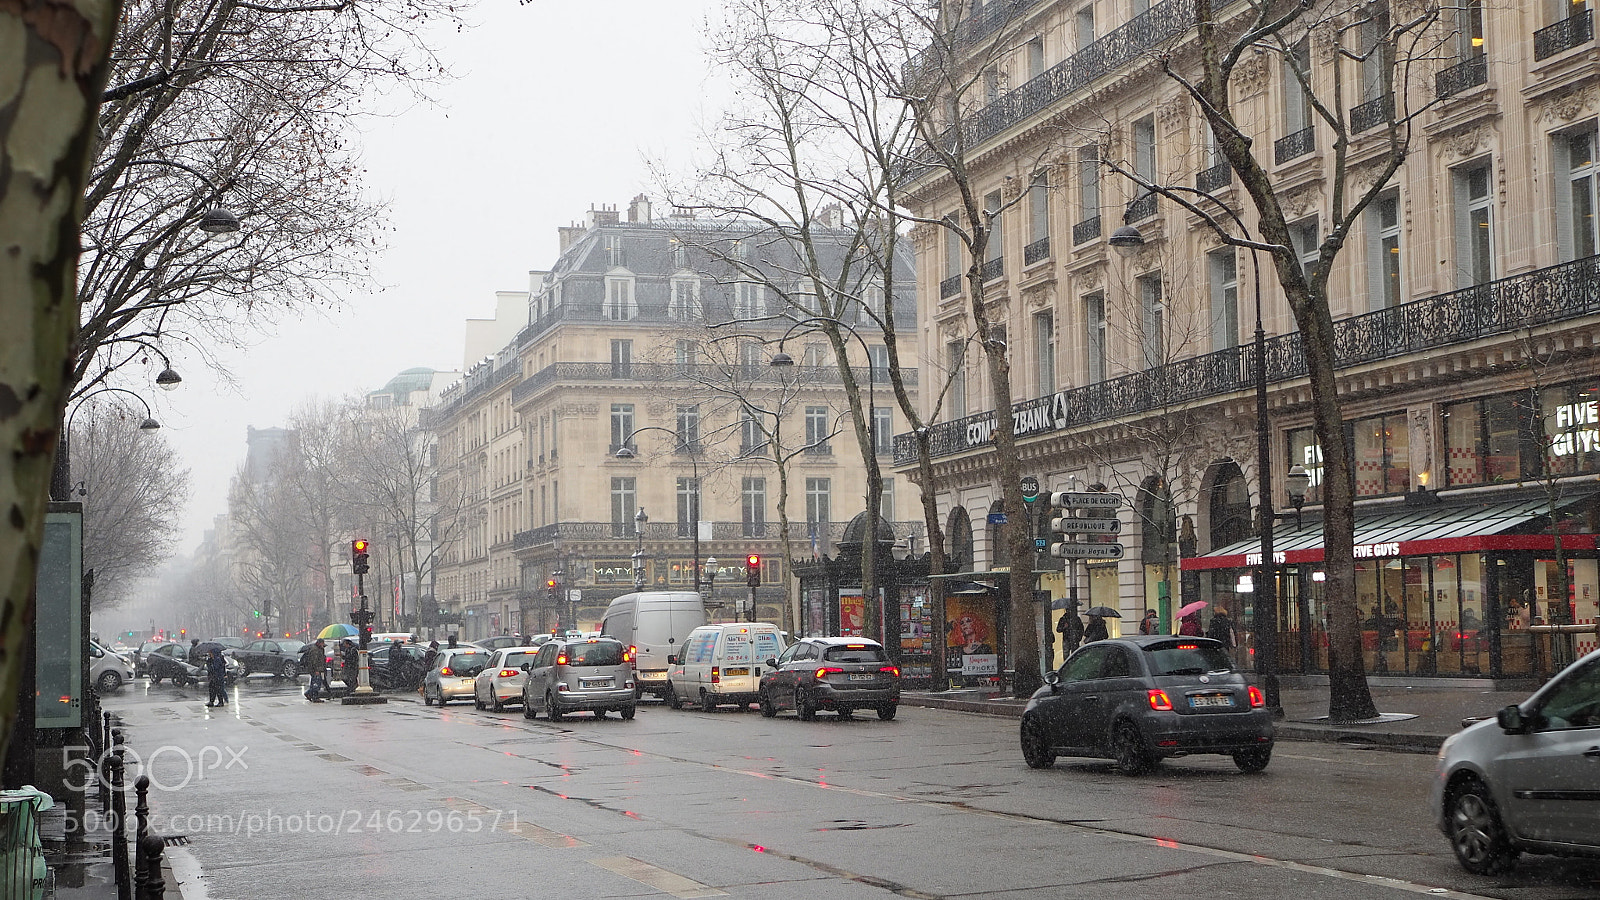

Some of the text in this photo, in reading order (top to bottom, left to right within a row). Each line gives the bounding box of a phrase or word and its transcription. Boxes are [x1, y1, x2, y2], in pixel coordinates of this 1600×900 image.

[1556, 400, 1599, 428] FIVE
[1552, 429, 1600, 457] GUYS
[1022, 483, 1037, 491] BUS
[1072, 497, 1090, 505] PLACE
[1090, 497, 1097, 505] DE
[1353, 542, 1400, 558] FIVE GUYS
[594, 567, 632, 575] MATY
